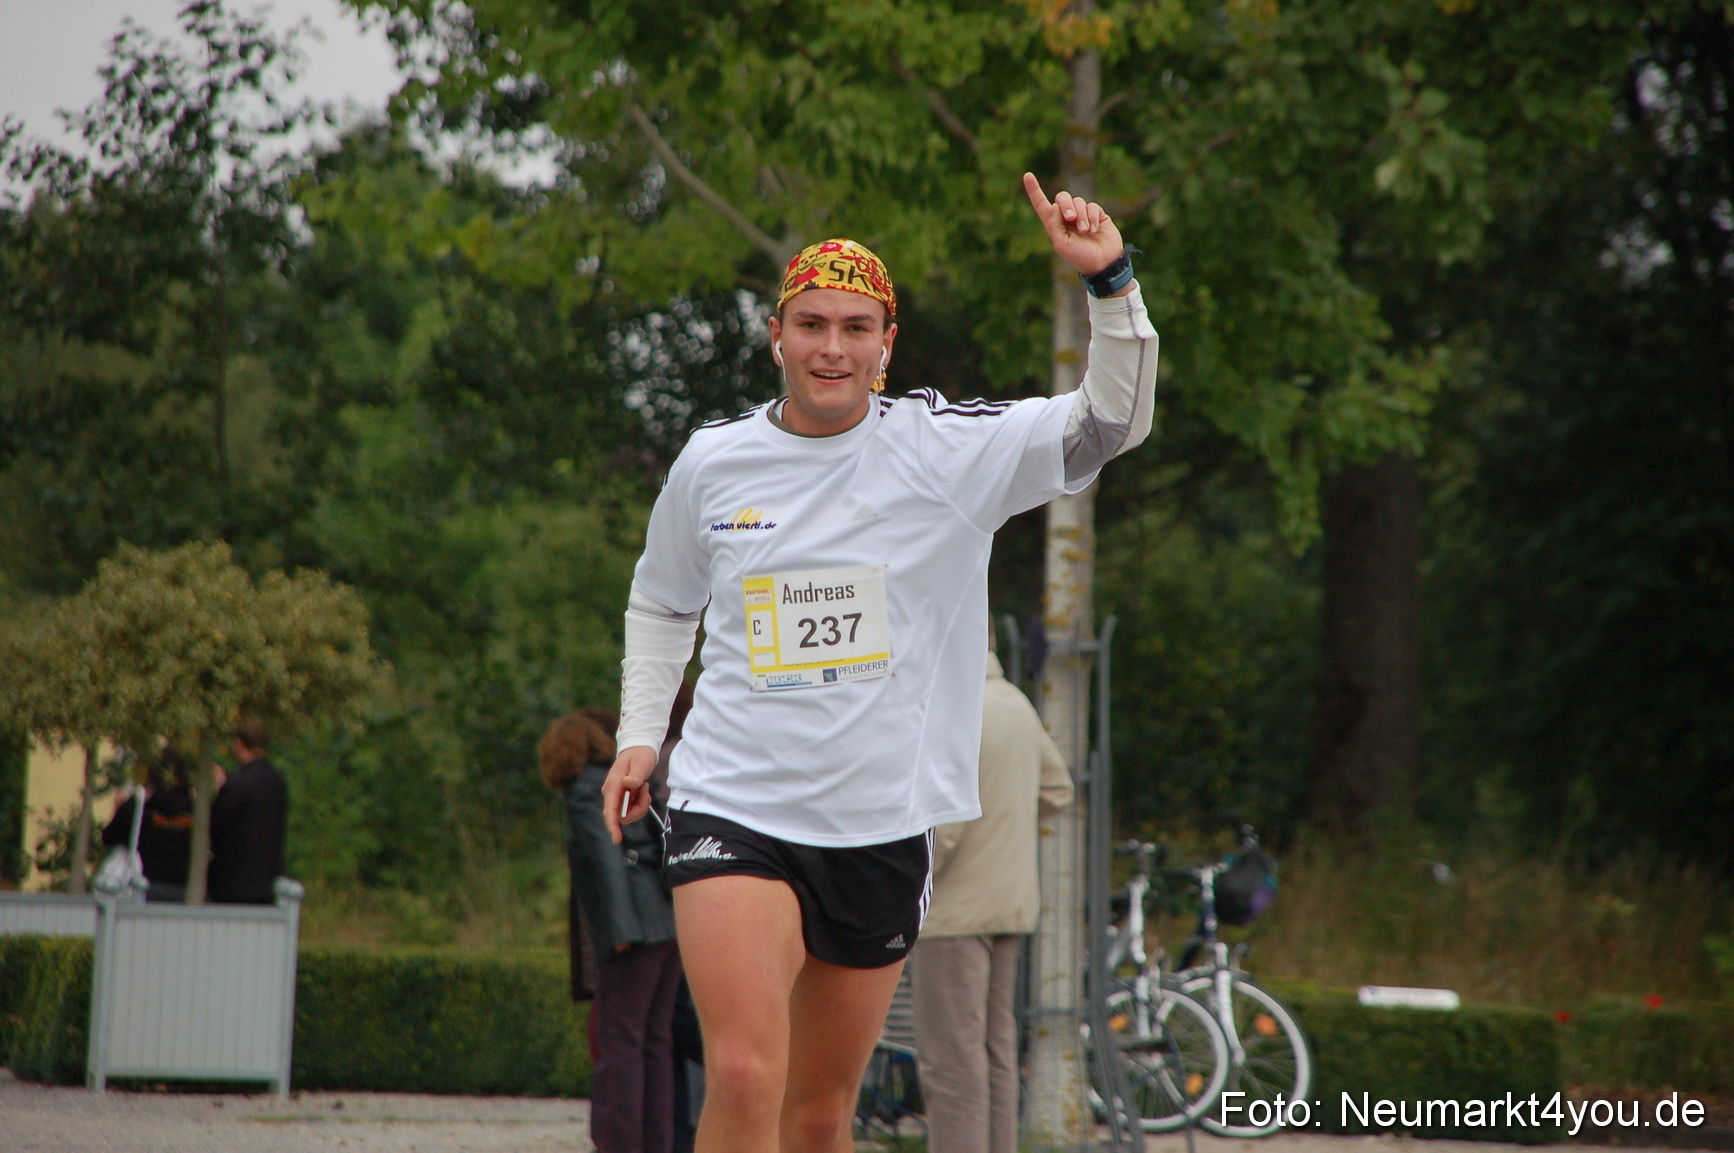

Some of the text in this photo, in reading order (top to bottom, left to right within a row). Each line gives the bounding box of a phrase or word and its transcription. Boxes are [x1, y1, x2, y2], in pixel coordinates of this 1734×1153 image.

[782, 581, 855, 605] Andreas
[753, 619, 762, 636] C
[797, 612, 863, 649] 237
[838, 659, 889, 676] PFLEIDERER
